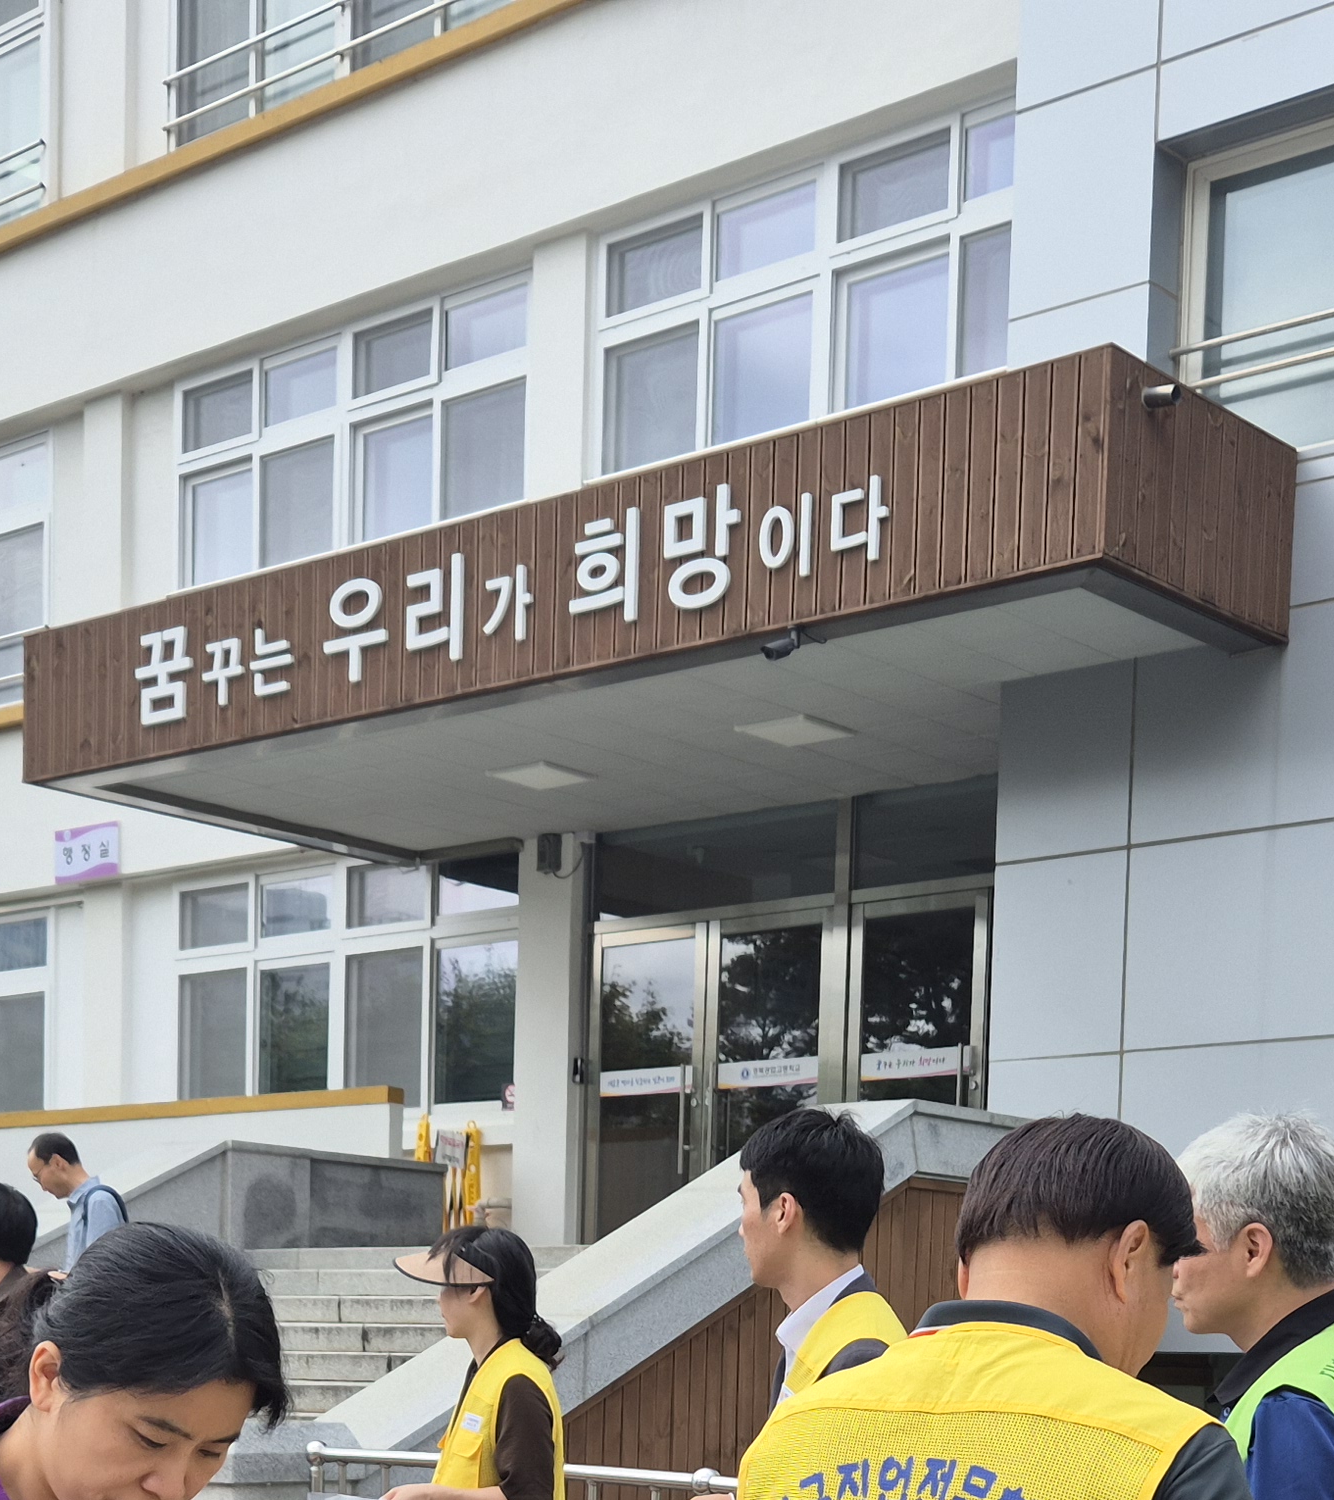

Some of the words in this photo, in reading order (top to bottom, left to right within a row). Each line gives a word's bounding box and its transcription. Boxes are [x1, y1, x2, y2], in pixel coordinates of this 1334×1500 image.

[134, 627, 295, 728] 꿈꾸는
[321, 552, 534, 684] 우리가
[567, 473, 891, 624] 희망이다
[62, 840, 110, 865] 행정실
